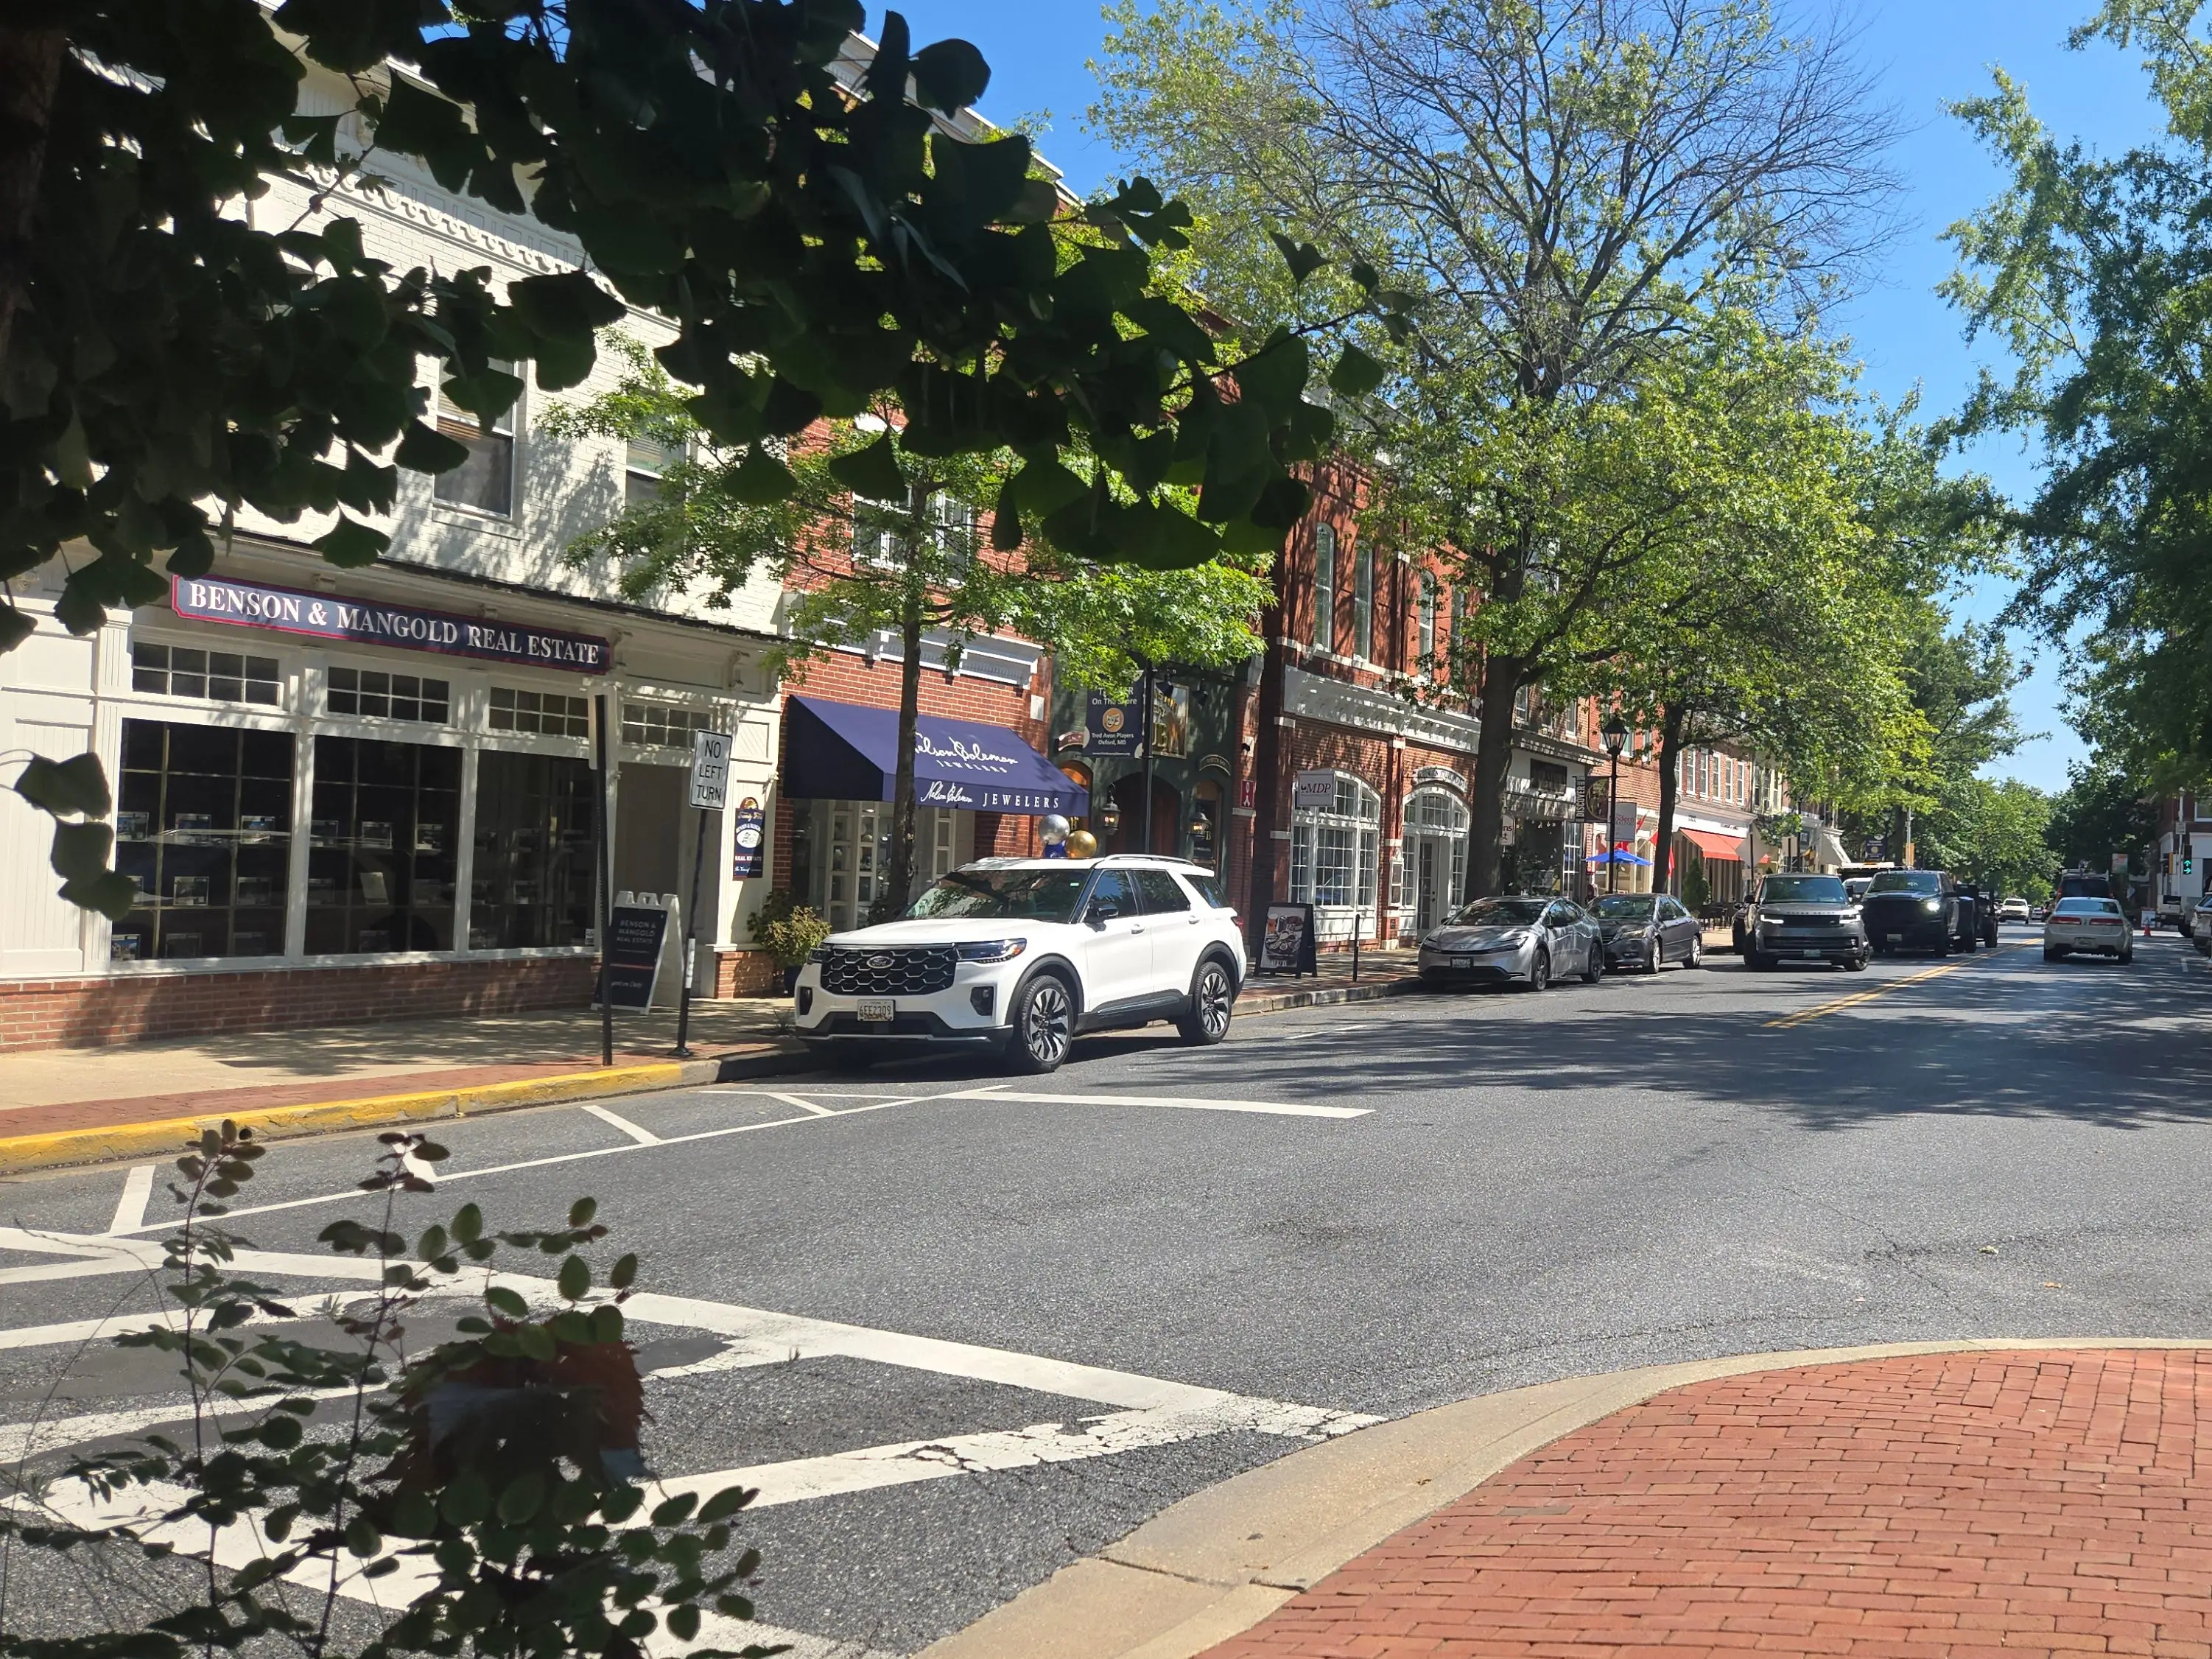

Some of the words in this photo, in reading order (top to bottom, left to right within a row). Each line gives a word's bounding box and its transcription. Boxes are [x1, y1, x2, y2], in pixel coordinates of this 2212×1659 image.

[189, 582, 301, 623] BENSON
[307, 600, 329, 626] &
[336, 608, 459, 645] MANGOLD
[467, 625, 523, 654] REAL
[527, 635, 600, 664] ESTATE
[704, 740, 722, 759] NO
[699, 763, 723, 780] LEFT
[696, 784, 722, 802] TURN
[921, 780, 947, 802] Nelson
[982, 793, 1060, 809] JEWELERS
[1576, 785, 1586, 817] DISCOVER
[619, 919, 650, 928] BENSON
[618, 929, 656, 937] MANGOLD
